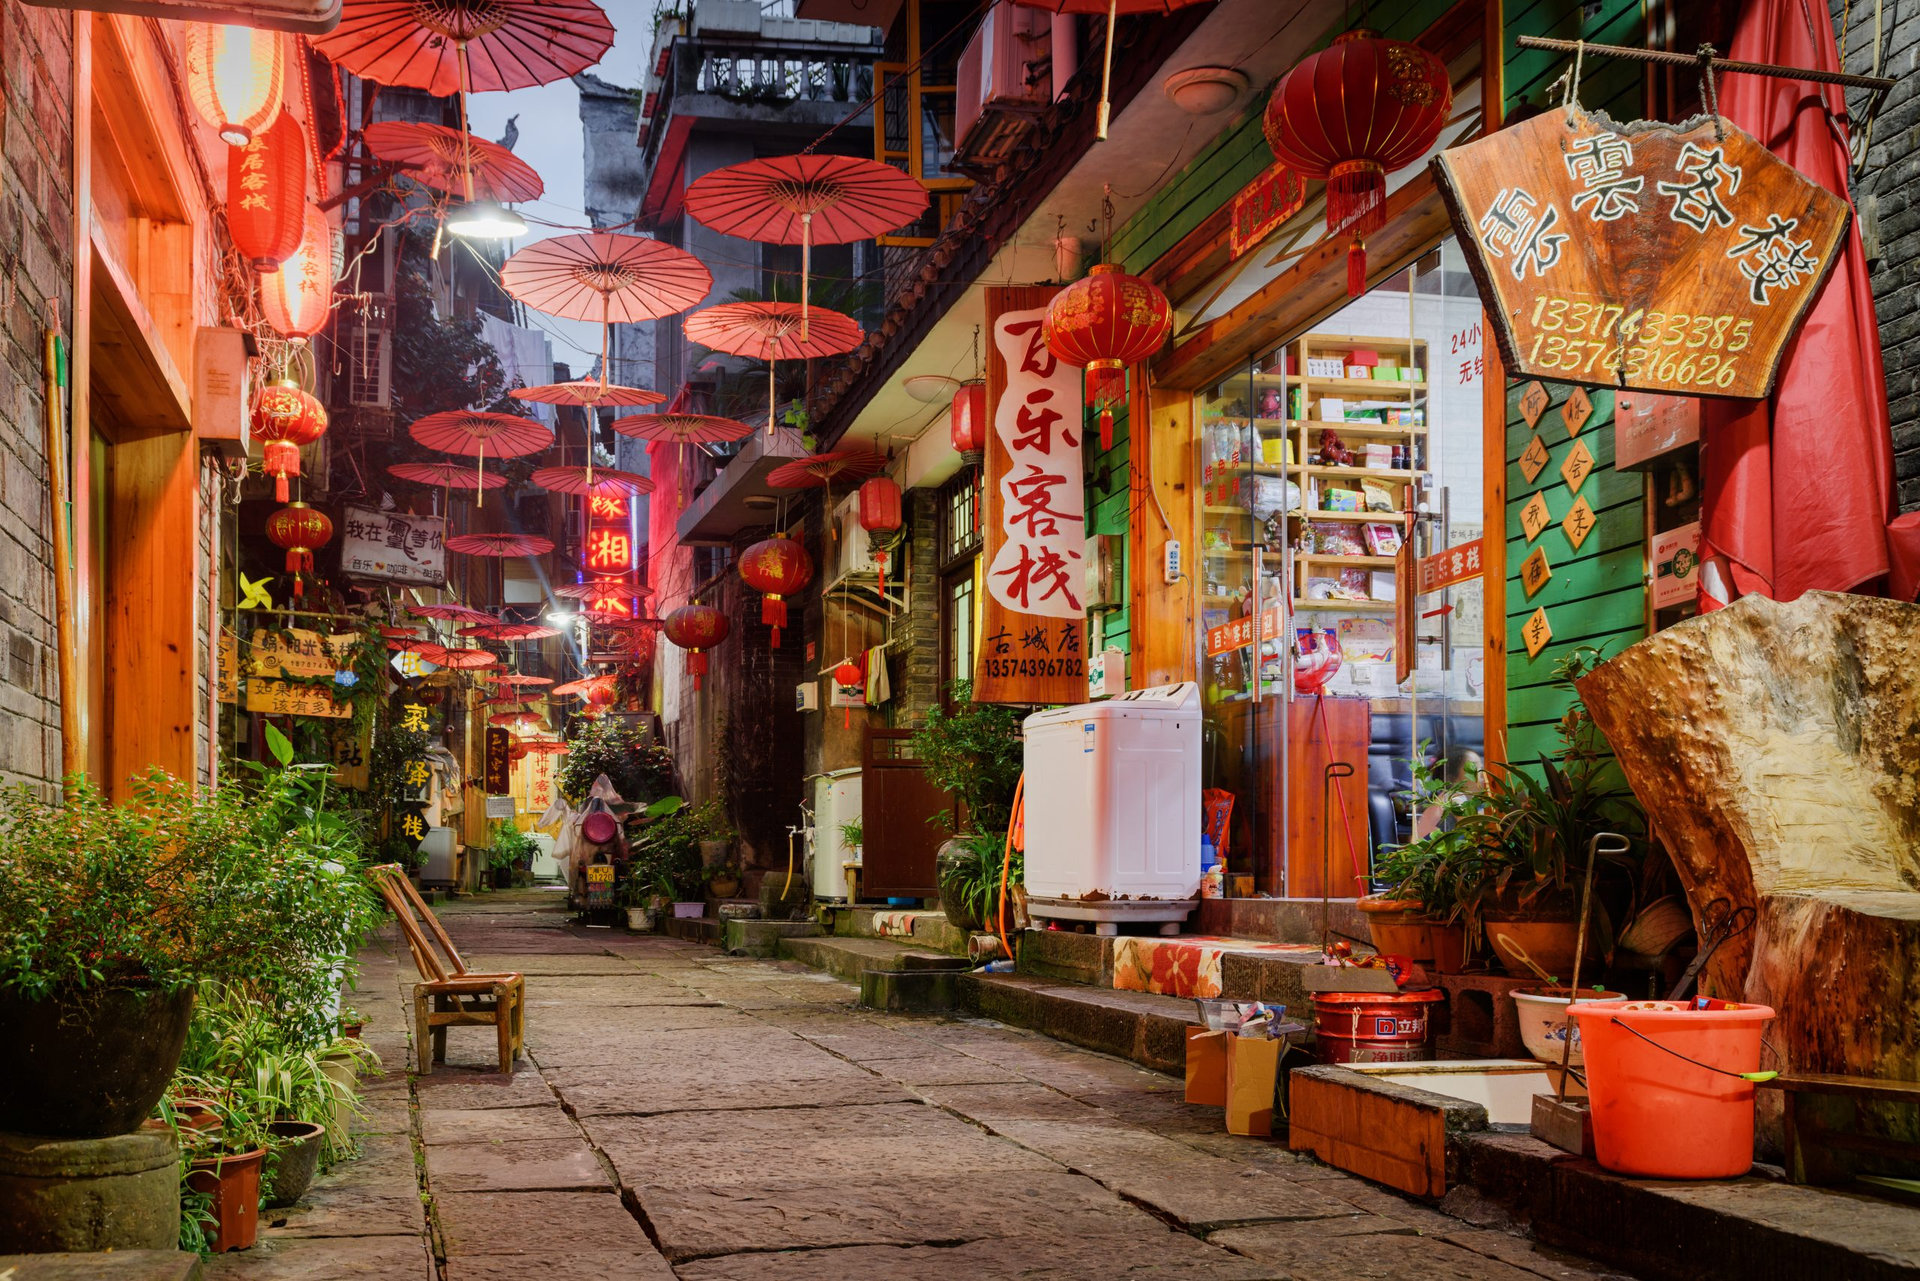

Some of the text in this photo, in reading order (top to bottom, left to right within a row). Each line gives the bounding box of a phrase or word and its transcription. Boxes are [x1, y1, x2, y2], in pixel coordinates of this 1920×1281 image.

[1531, 296, 1753, 352] 13317433385
[1529, 334, 1739, 388] 13574316626
[993, 317, 1083, 611] 百乐客栈
[987, 623, 1080, 655] 古城店
[984, 658, 1083, 678] 13574396782
